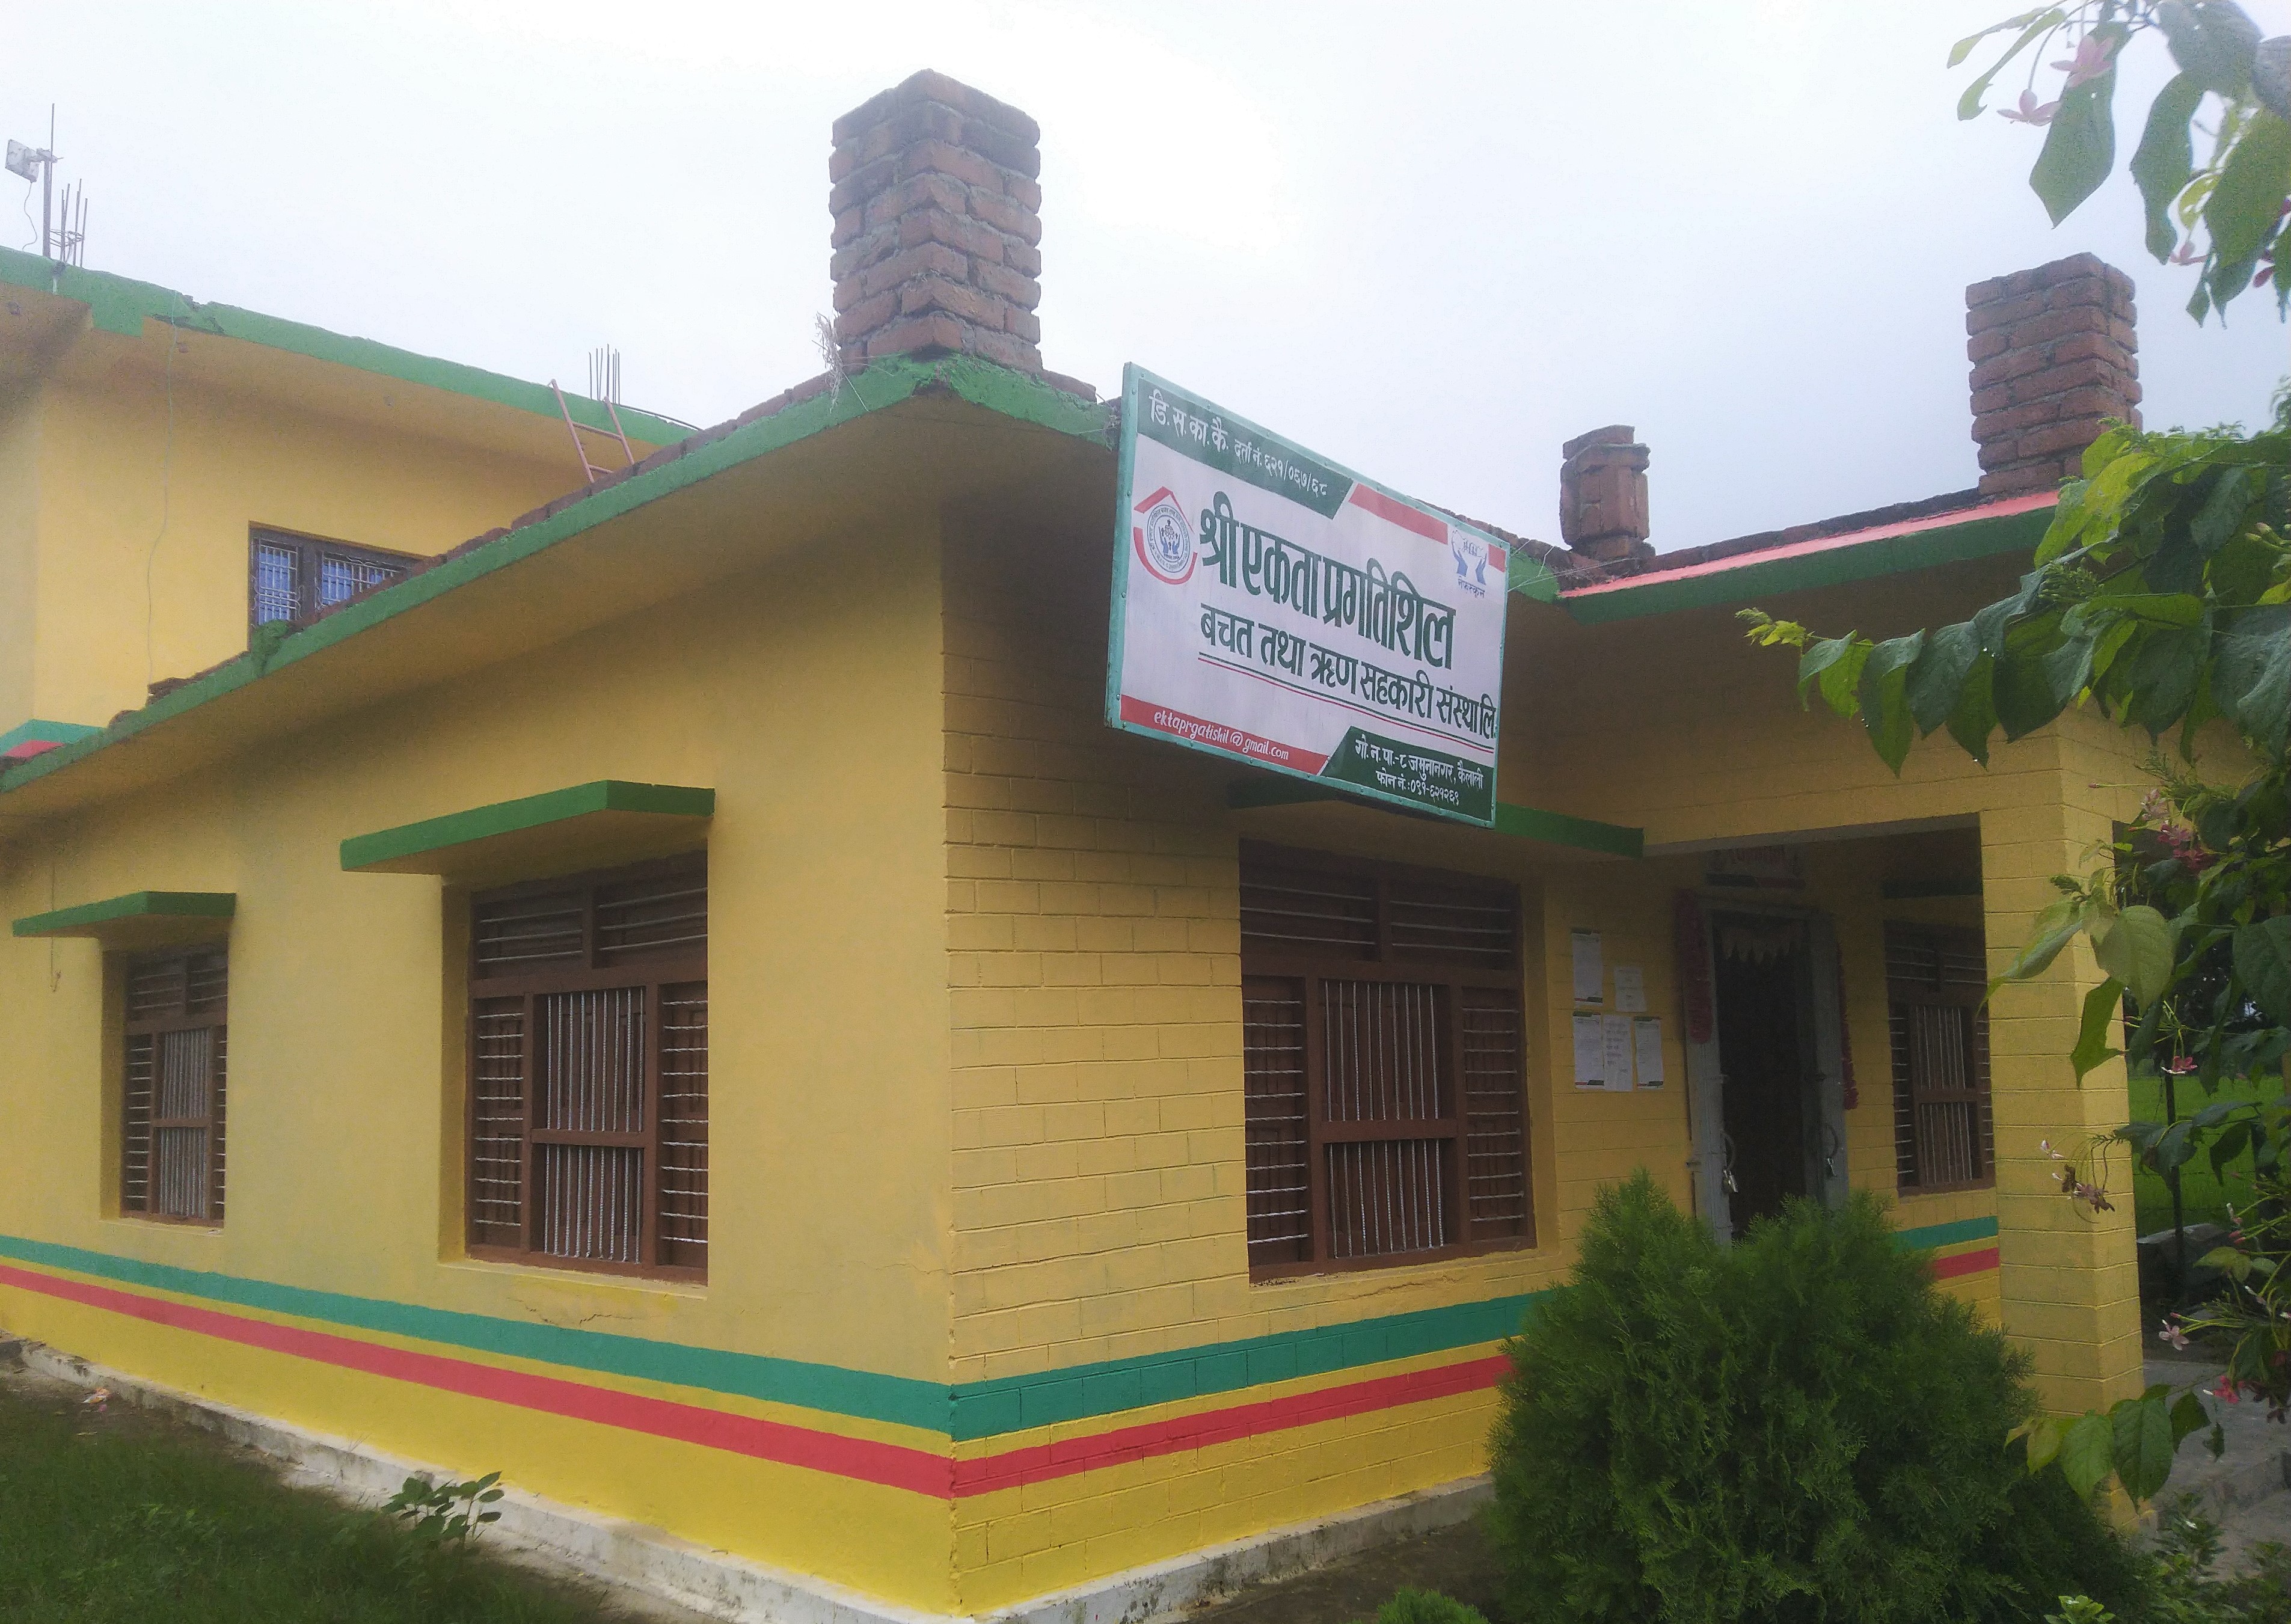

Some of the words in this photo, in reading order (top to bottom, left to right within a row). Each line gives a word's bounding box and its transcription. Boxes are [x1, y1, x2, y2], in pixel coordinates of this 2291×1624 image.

[1201, 603, 1255, 659] बचत
[1259, 623, 1307, 677] तथा
[1309, 642, 1359, 694] ऋण
[1360, 661, 1434, 720] सहकारी
[1375, 767, 1397, 789] फोन
